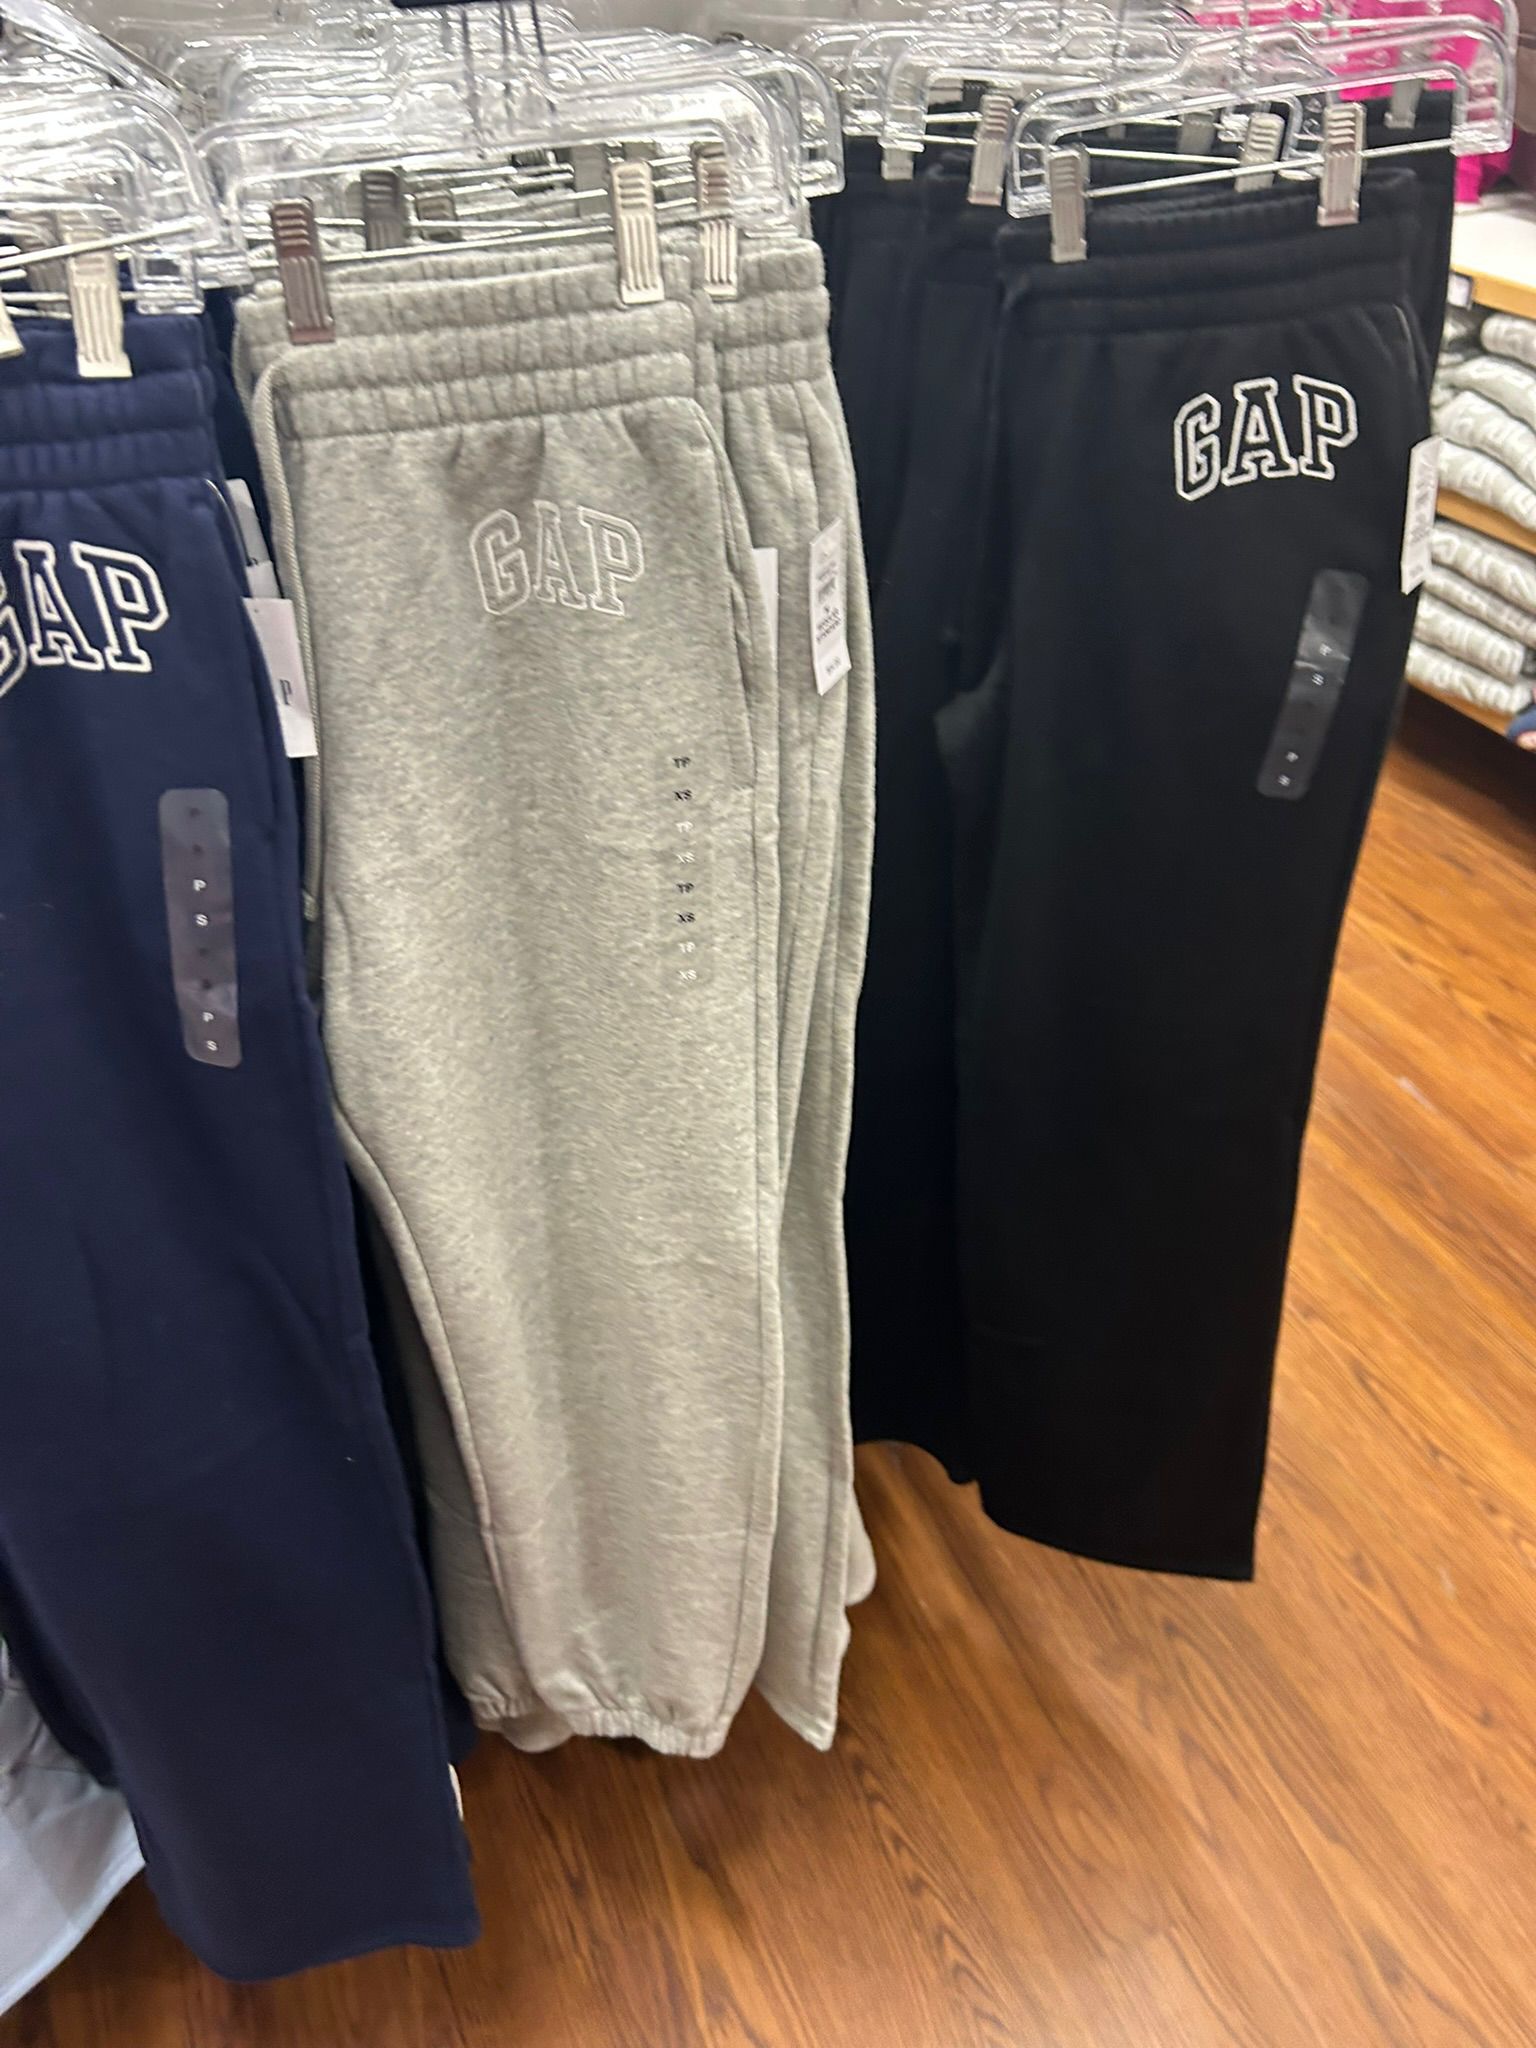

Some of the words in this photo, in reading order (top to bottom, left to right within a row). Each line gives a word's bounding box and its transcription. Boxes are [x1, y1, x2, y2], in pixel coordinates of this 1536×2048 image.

[1173, 374, 1358, 500] GAP
[469, 501, 646, 617] GAP
[673, 789, 692, 801] XS
[193, 879, 207, 891] P
[195, 914, 208, 926] S
[676, 912, 696, 923] XS
[207, 1040, 218, 1051] S
